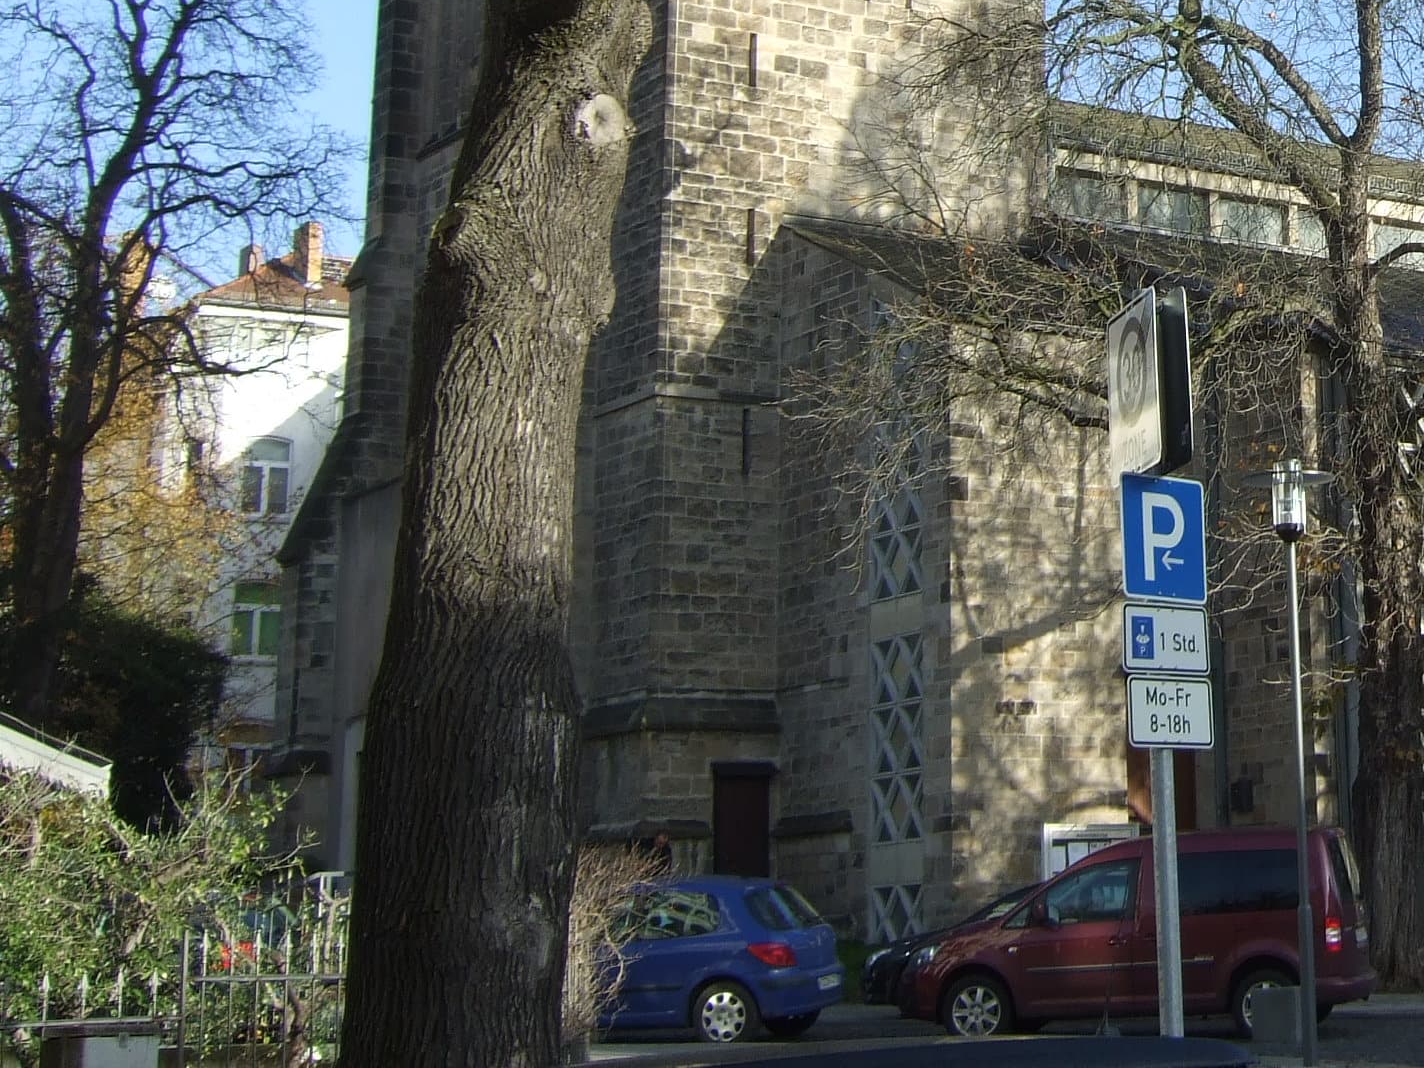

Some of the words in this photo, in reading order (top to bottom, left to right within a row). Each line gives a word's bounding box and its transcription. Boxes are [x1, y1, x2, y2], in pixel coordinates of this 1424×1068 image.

[1122, 429, 1147, 465] ZONE
[1141, 491, 1185, 581] P
[1160, 632, 1165, 651] 1
[1173, 633, 1200, 653] Std.
[1146, 686, 1191, 707] Mo-Fr
[1150, 713, 1191, 734] 8-18h
